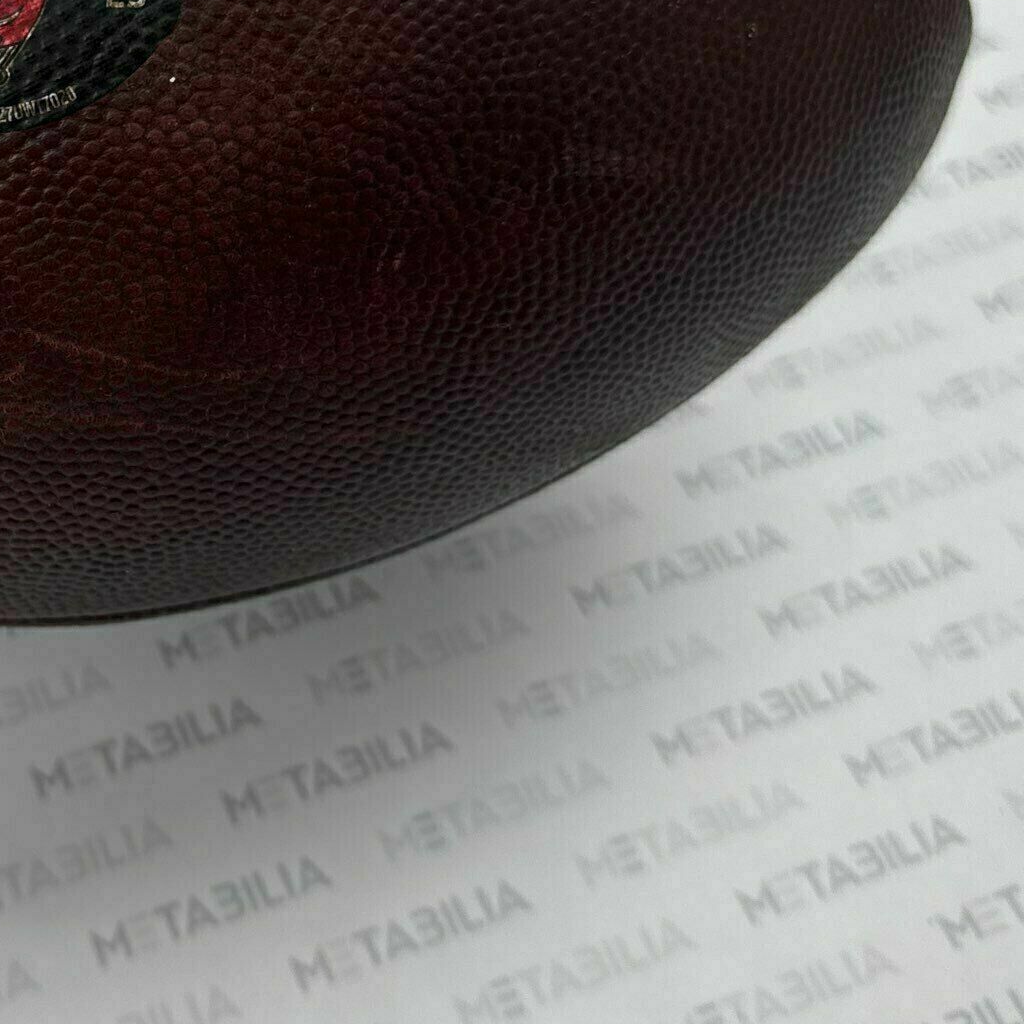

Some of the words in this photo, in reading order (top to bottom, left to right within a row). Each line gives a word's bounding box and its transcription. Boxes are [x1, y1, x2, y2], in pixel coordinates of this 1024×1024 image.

[156, 575, 382, 670] METABILIA
[568, 521, 791, 618] METABILIA
[756, 543, 977, 640] METABILIA
[28, 696, 264, 800] METABILIA
[648, 663, 878, 769] METABILIA
[220, 720, 456, 829] METABILIA
[88, 854, 334, 969] METABILIA
[734, 814, 970, 927] METABILIA
[288, 878, 534, 995] METABILIA
